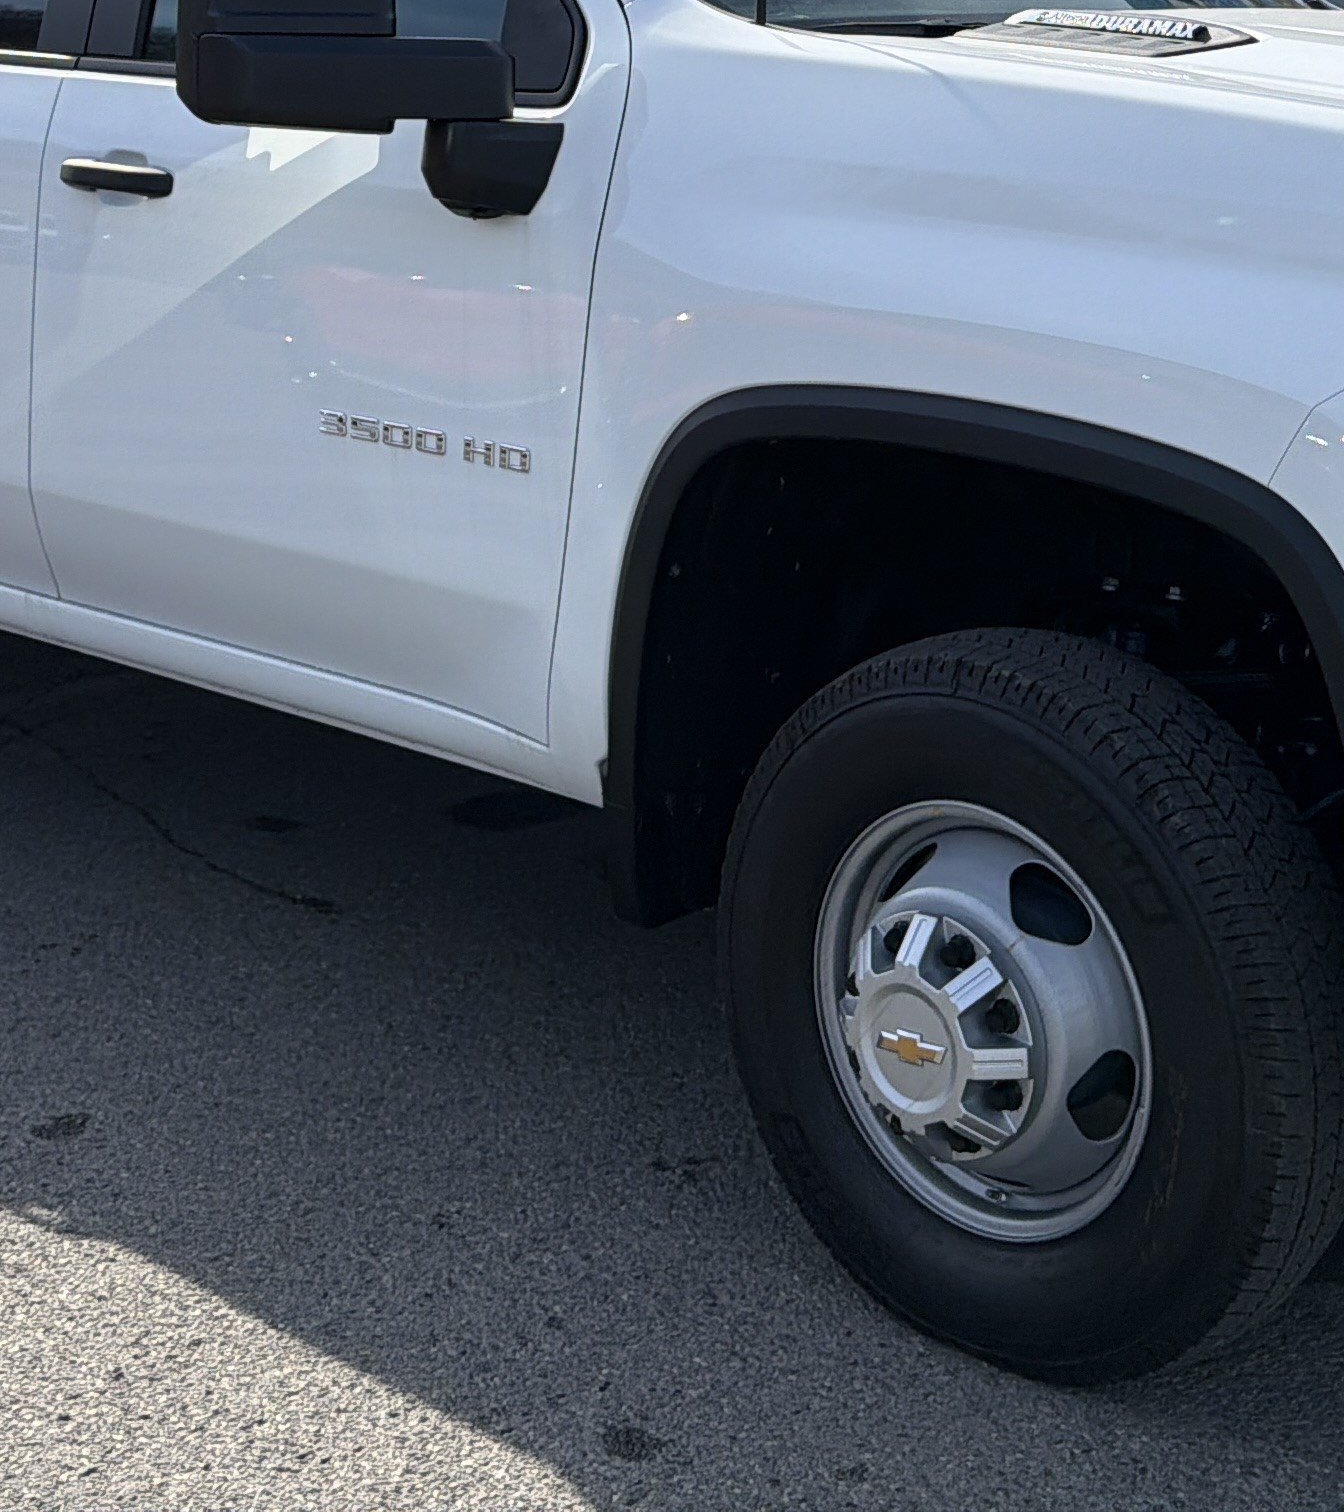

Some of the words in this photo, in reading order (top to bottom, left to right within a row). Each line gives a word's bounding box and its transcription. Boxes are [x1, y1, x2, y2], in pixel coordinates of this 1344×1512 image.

[1090, 13, 1197, 39] DURAMAX
[319, 407, 447, 456] 3500
[463, 435, 532, 474] HD
